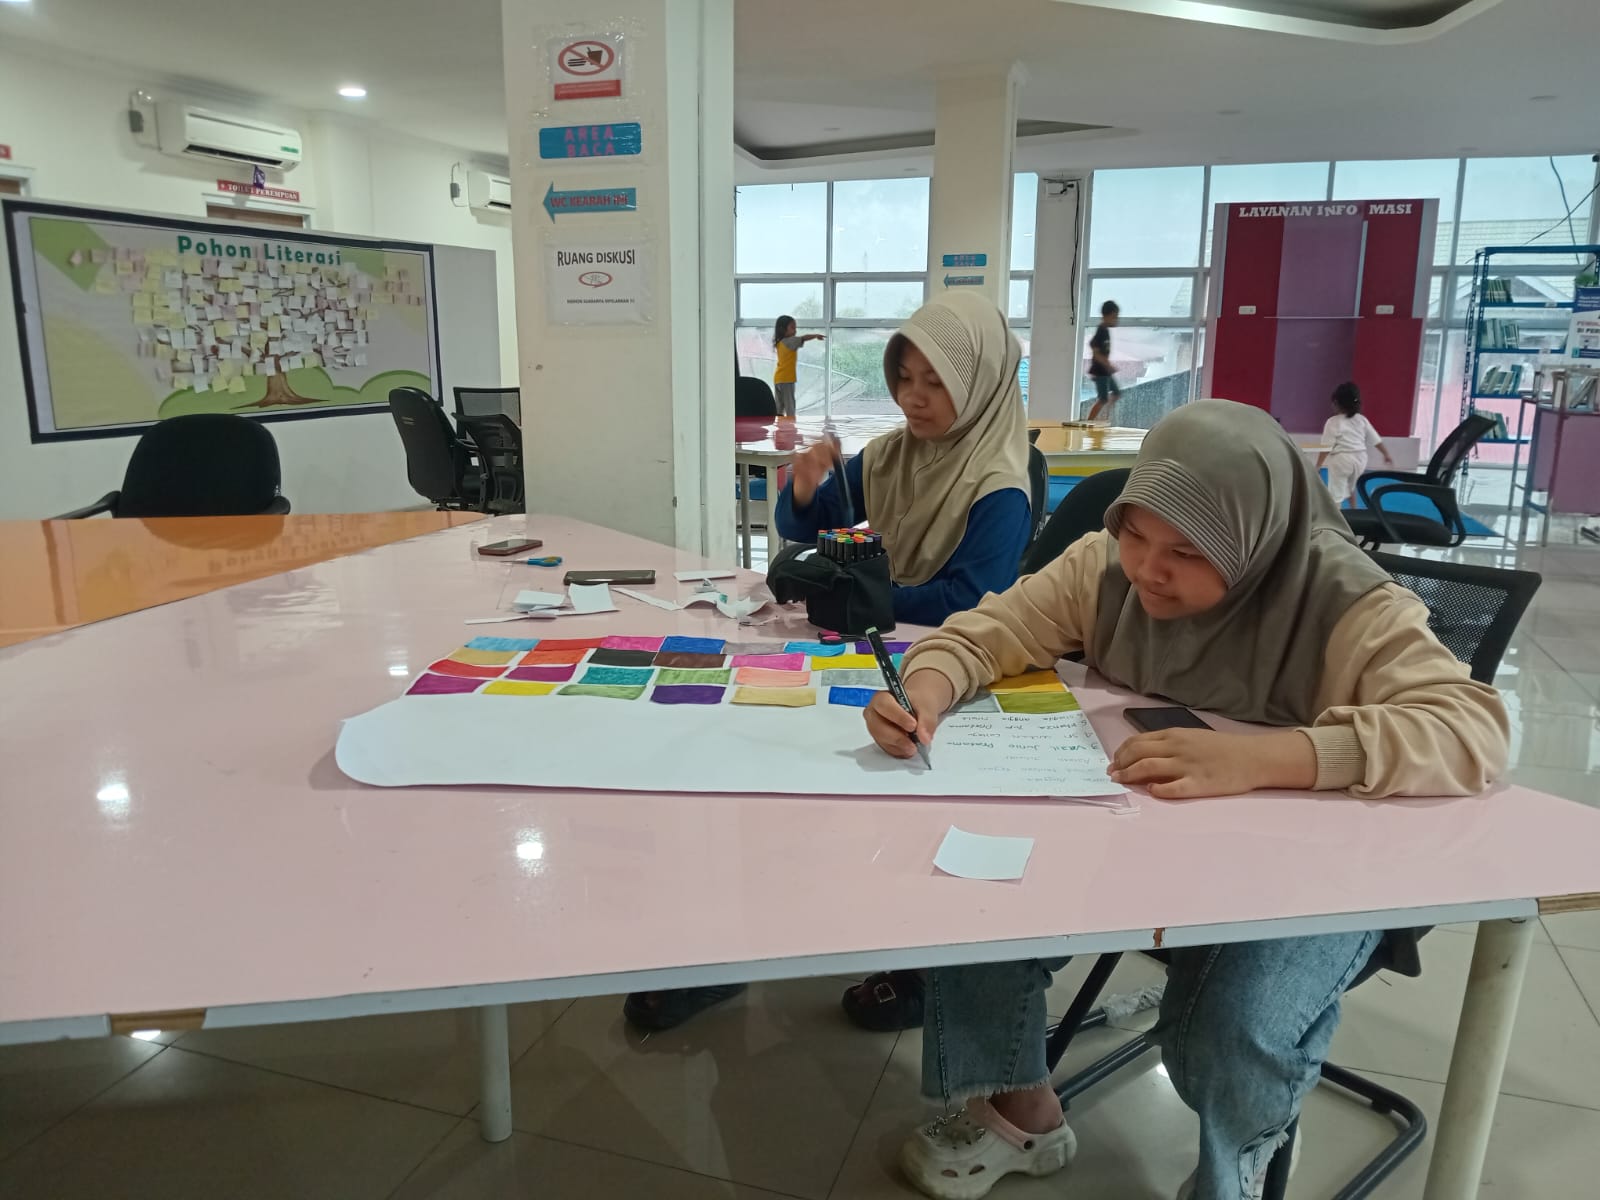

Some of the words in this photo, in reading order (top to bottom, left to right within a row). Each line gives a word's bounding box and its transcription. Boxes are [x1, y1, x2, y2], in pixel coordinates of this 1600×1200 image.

[564, 126, 614, 142] AREA
[567, 141, 616, 158] BACA
[256, 187, 297, 200] PEREMPUAN
[550, 197, 567, 208] WC
[570, 195, 611, 207] KEARAH
[1239, 203, 1313, 218] LAYANAN
[1316, 203, 1358, 217] INFO
[1368, 203, 1413, 215] MASI
[177, 235, 251, 259] Pohon
[263, 243, 342, 266] Literasi
[557, 250, 593, 267] RUANG
[596, 248, 635, 265] DISKUSI
